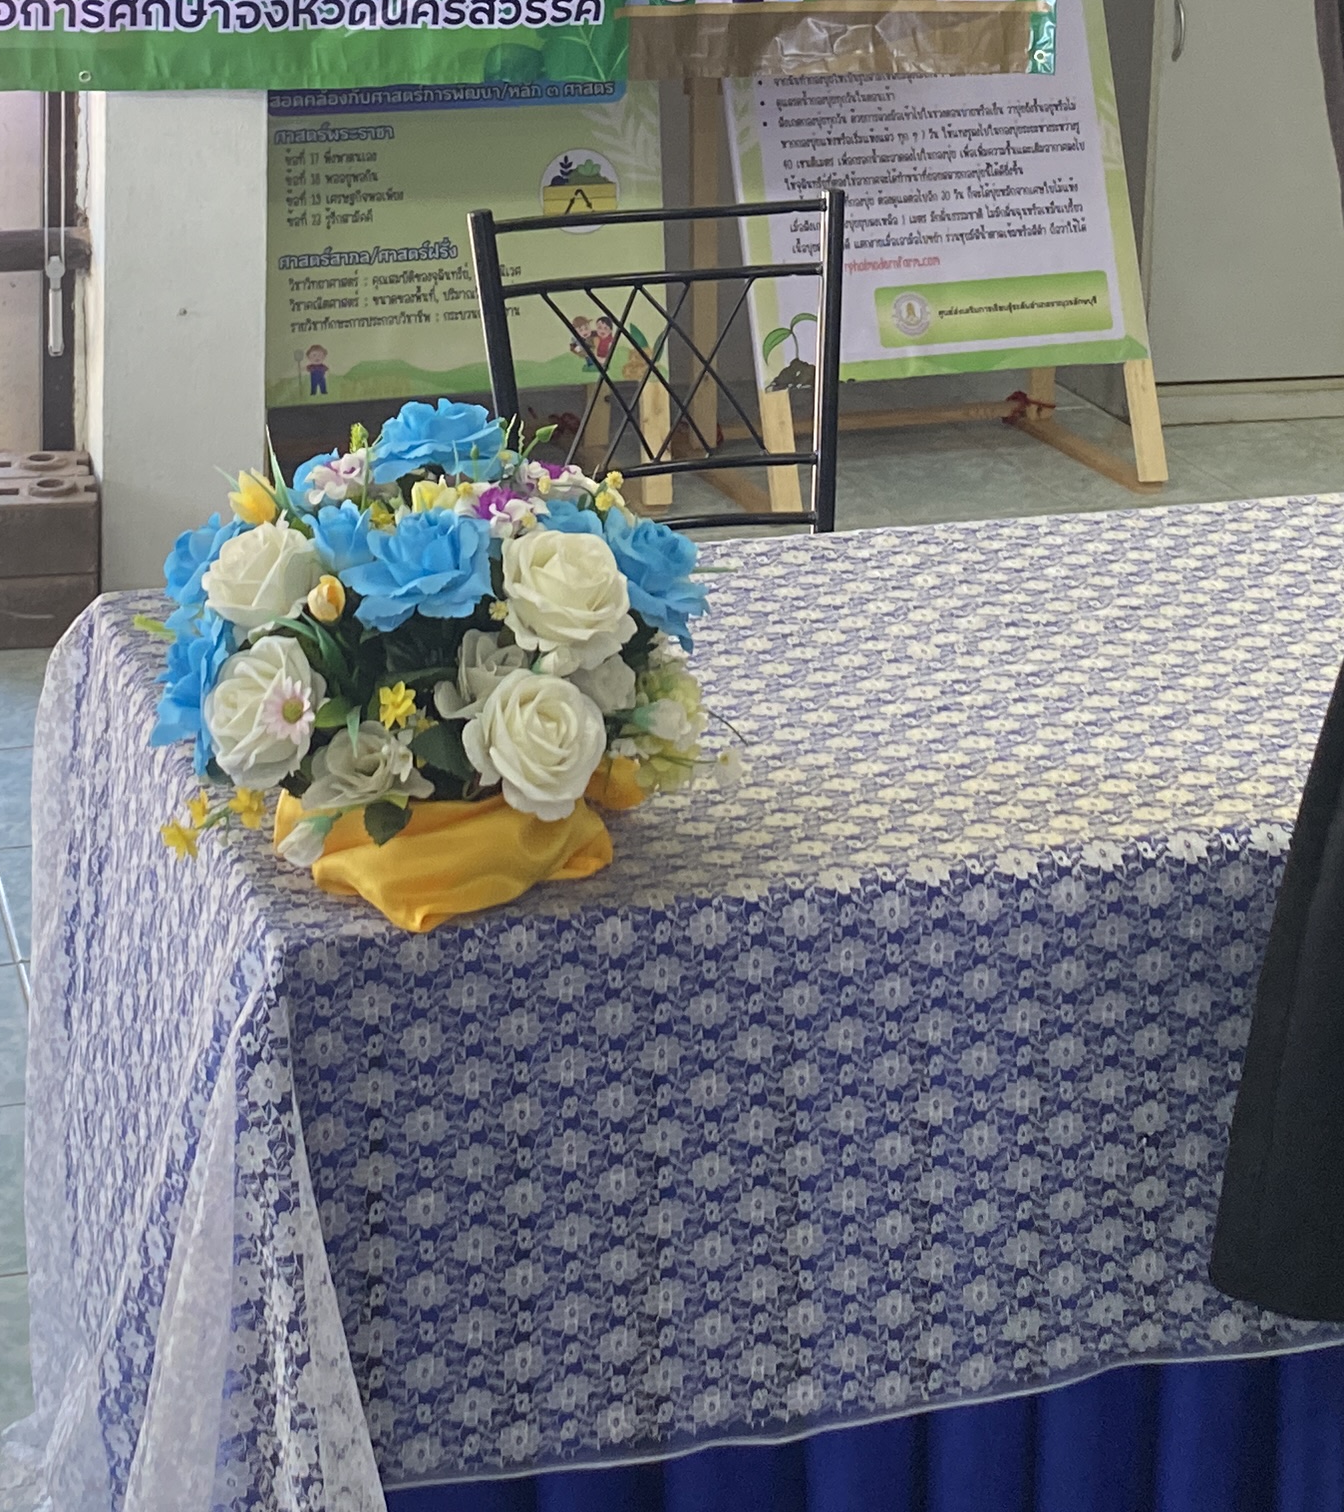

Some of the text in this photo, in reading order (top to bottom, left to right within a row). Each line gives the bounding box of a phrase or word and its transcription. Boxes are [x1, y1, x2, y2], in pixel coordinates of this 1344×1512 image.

[564, 82, 613, 97] ศาสตร
[274, 121, 395, 144] ศาสตร์พระราชา
[279, 237, 458, 270] ศาสตร์สากล/ศาสตร์ฝรั่ง
